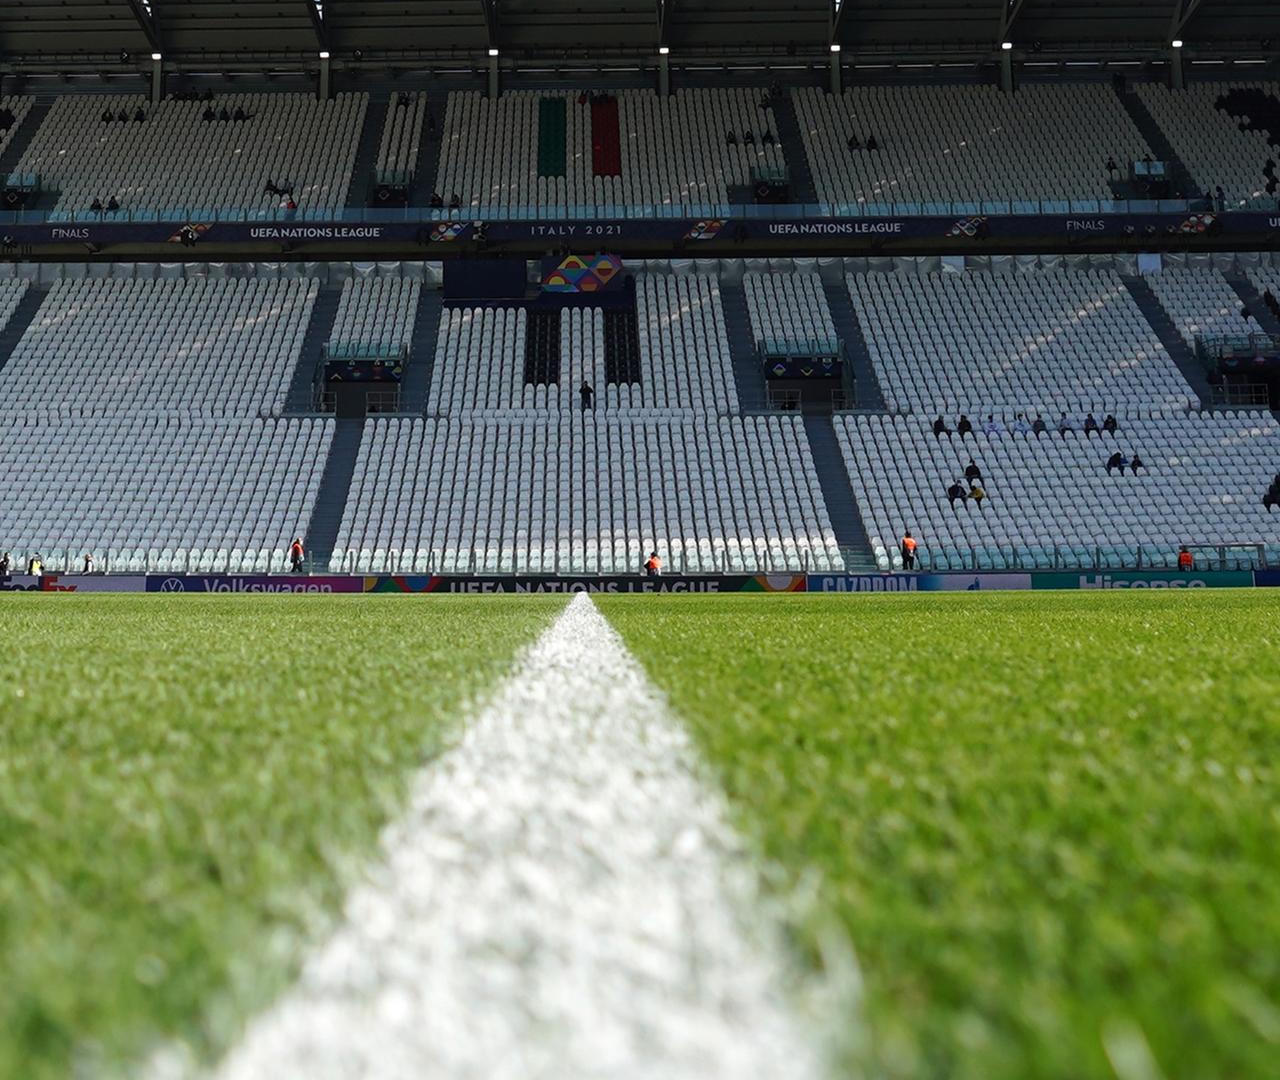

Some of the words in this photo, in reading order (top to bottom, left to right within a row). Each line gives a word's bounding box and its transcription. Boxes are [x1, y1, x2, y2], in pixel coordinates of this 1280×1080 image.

[531, 226, 576, 235] ITALY
[585, 225, 621, 235] 2021
[769, 224, 800, 234] UEFA
[801, 224, 853, 234] NATIONS
[855, 223, 901, 233] LEAGUE
[1066, 220, 1105, 231] FINALS
[51, 228, 89, 238] FINALS
[250, 229, 280, 239] UEFA
[281, 228, 332, 238] NATIONS
[334, 227, 380, 238] LEAGUE
[204, 578, 333, 593] Volkswagen
